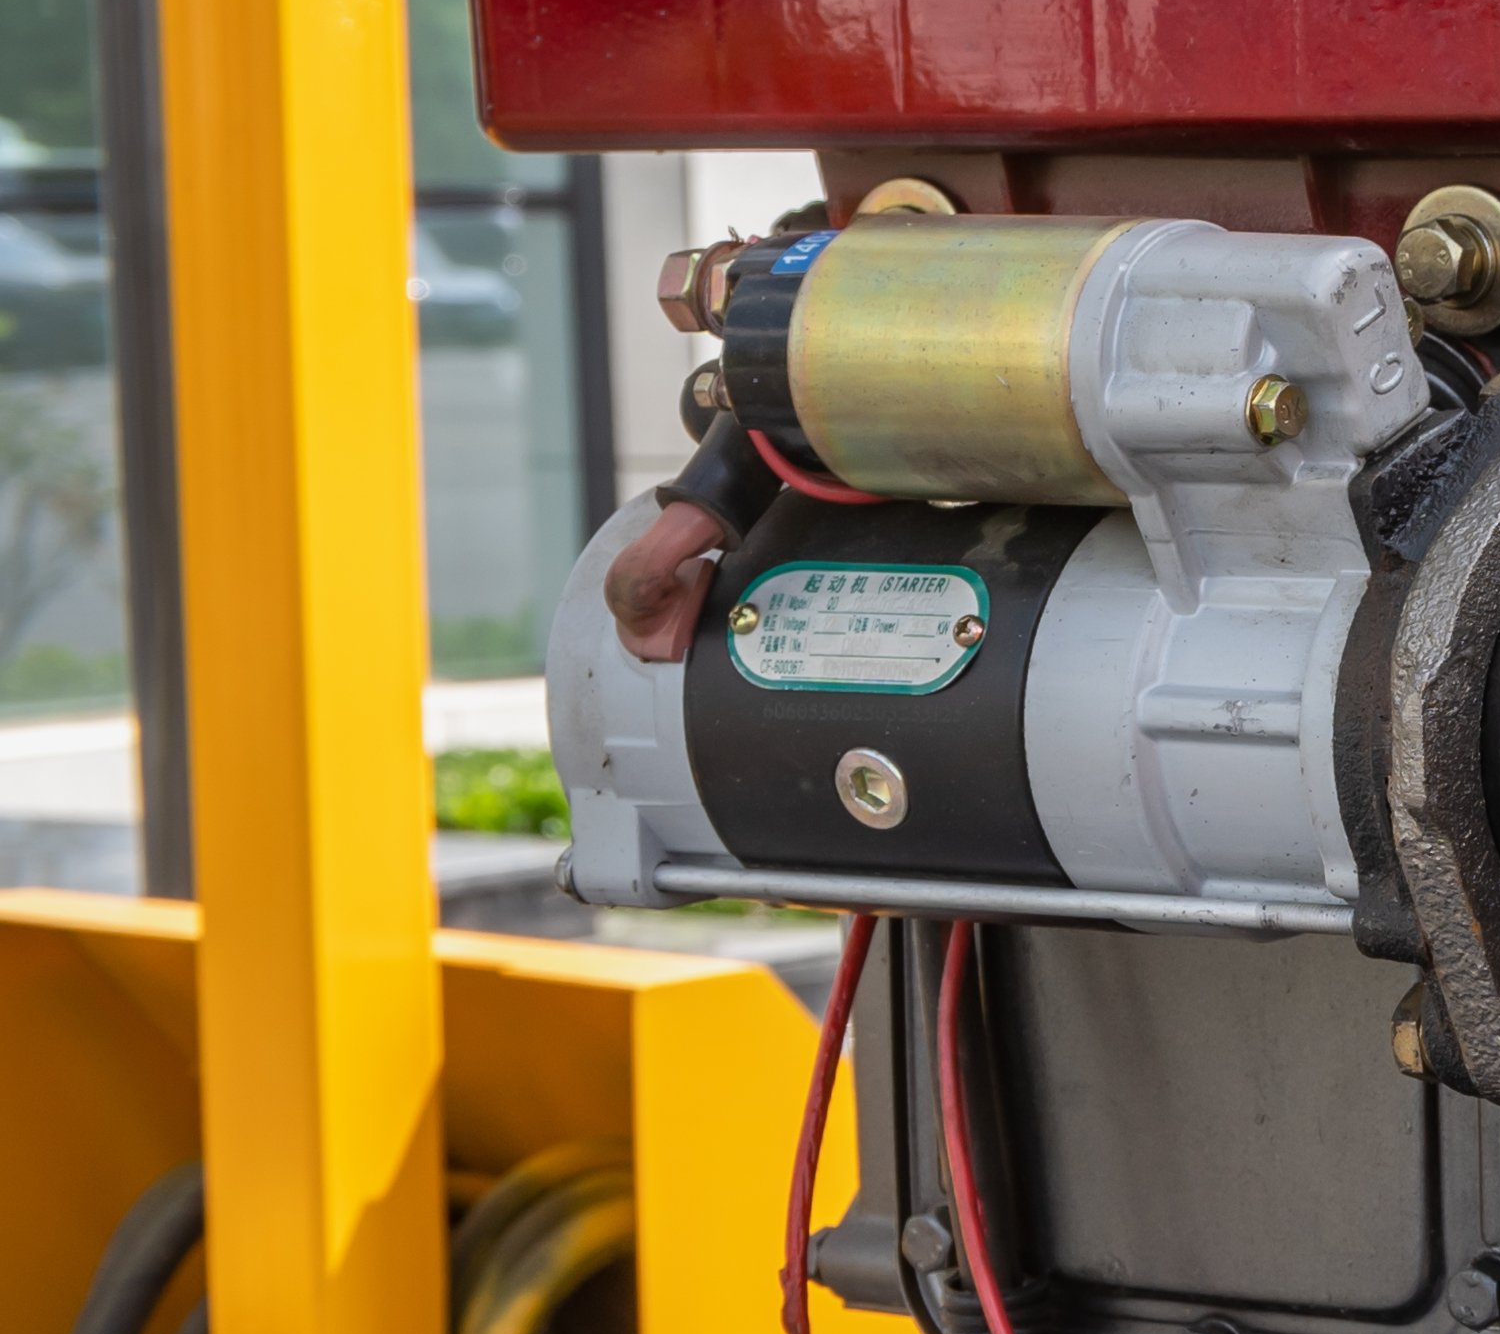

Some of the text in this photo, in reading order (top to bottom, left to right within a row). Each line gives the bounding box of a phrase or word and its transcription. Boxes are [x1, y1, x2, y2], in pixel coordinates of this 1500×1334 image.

[803, 573, 951, 597] 起动机 (STARTER)
